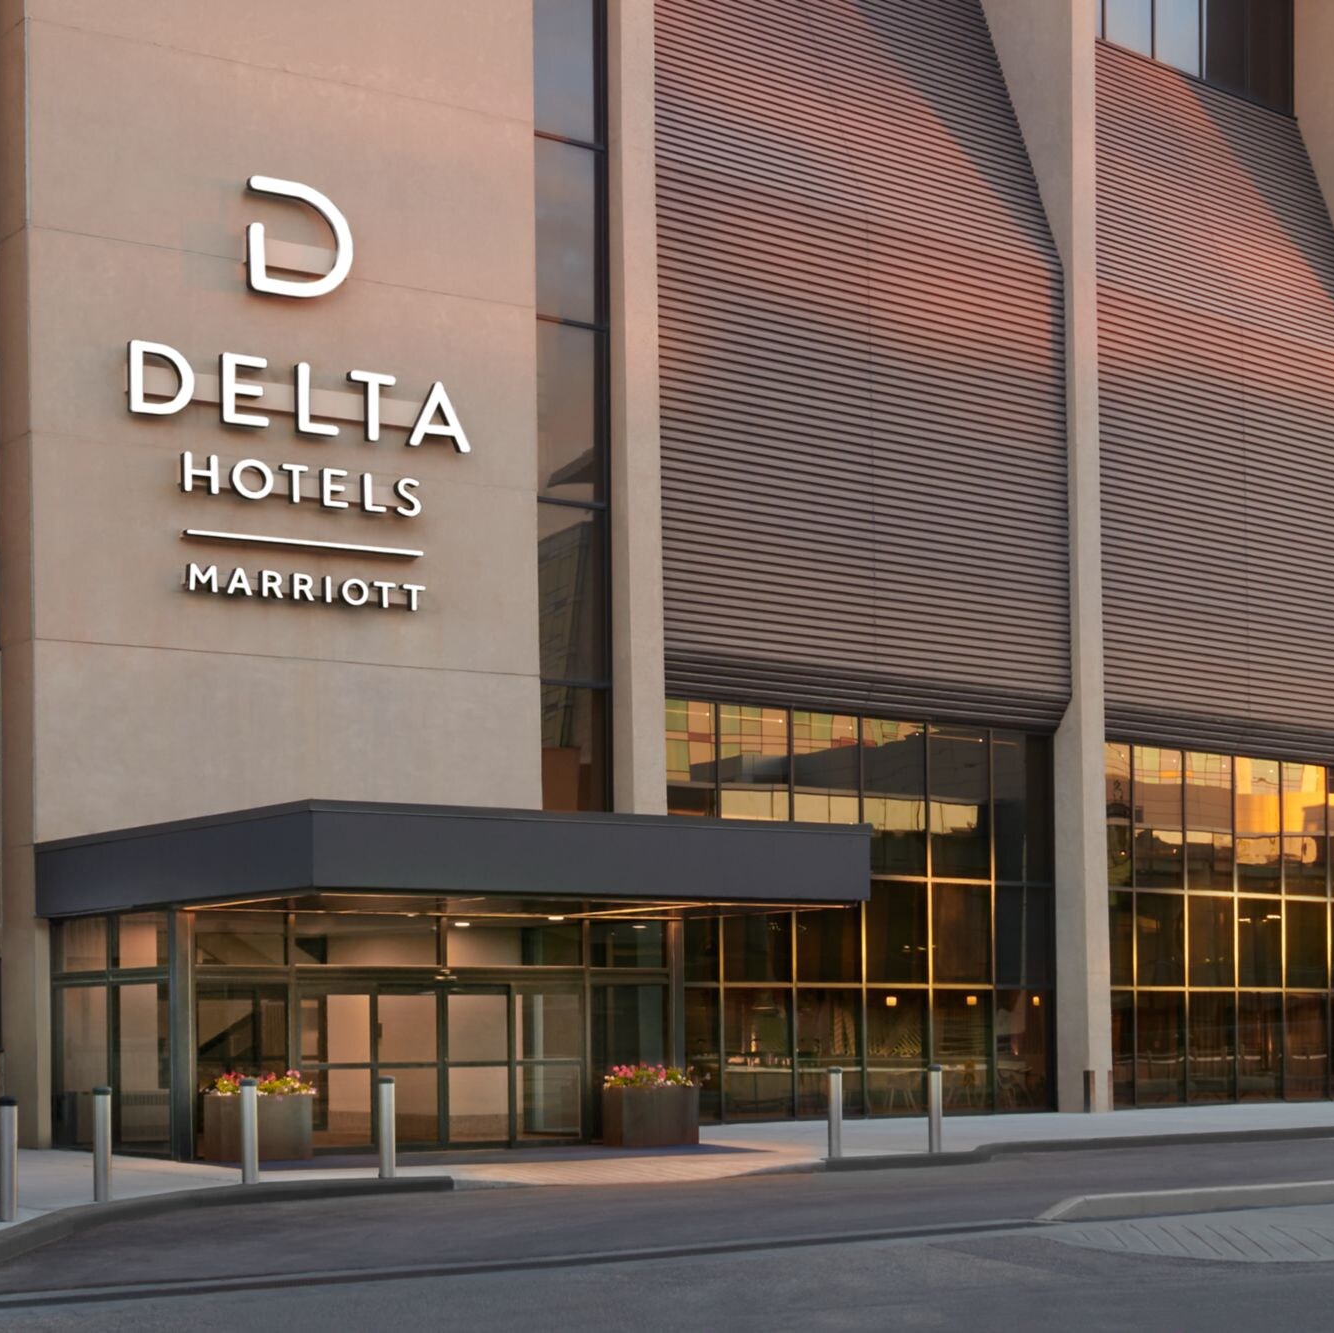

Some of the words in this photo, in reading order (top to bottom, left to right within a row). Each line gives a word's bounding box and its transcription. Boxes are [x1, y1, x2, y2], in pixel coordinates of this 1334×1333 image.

[127, 339, 471, 454] DELTA
[180, 451, 422, 517] HOTELS
[185, 563, 426, 612] MARRIOTT
